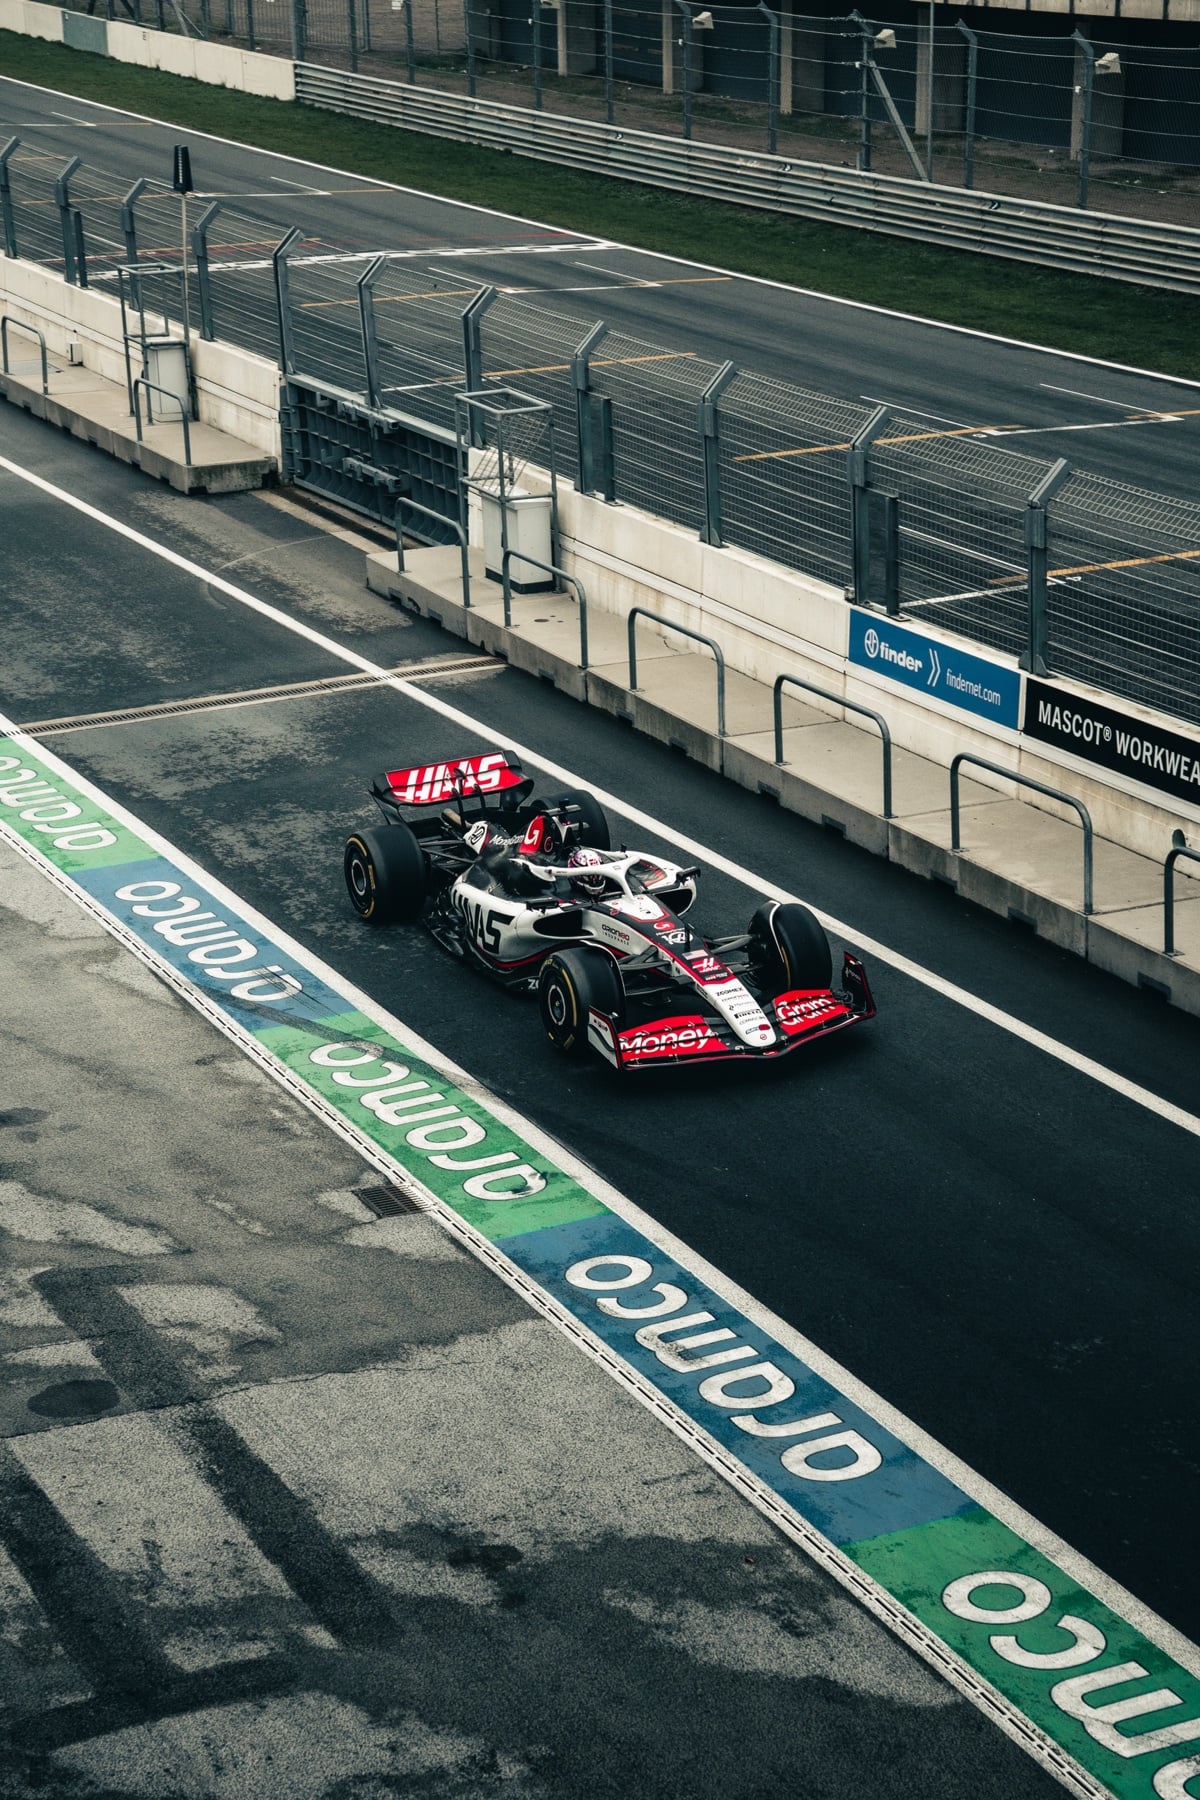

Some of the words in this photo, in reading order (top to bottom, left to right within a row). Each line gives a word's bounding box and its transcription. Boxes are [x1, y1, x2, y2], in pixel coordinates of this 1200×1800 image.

[879, 645, 923, 672] finder
[946, 669, 1001, 706] findernet.com
[114, 881, 303, 1001] aramco
[777, 995, 837, 1025] Gram
[620, 1029, 712, 1055] Money
[309, 1040, 548, 1200] aramco
[564, 1254, 883, 1482] aramco
